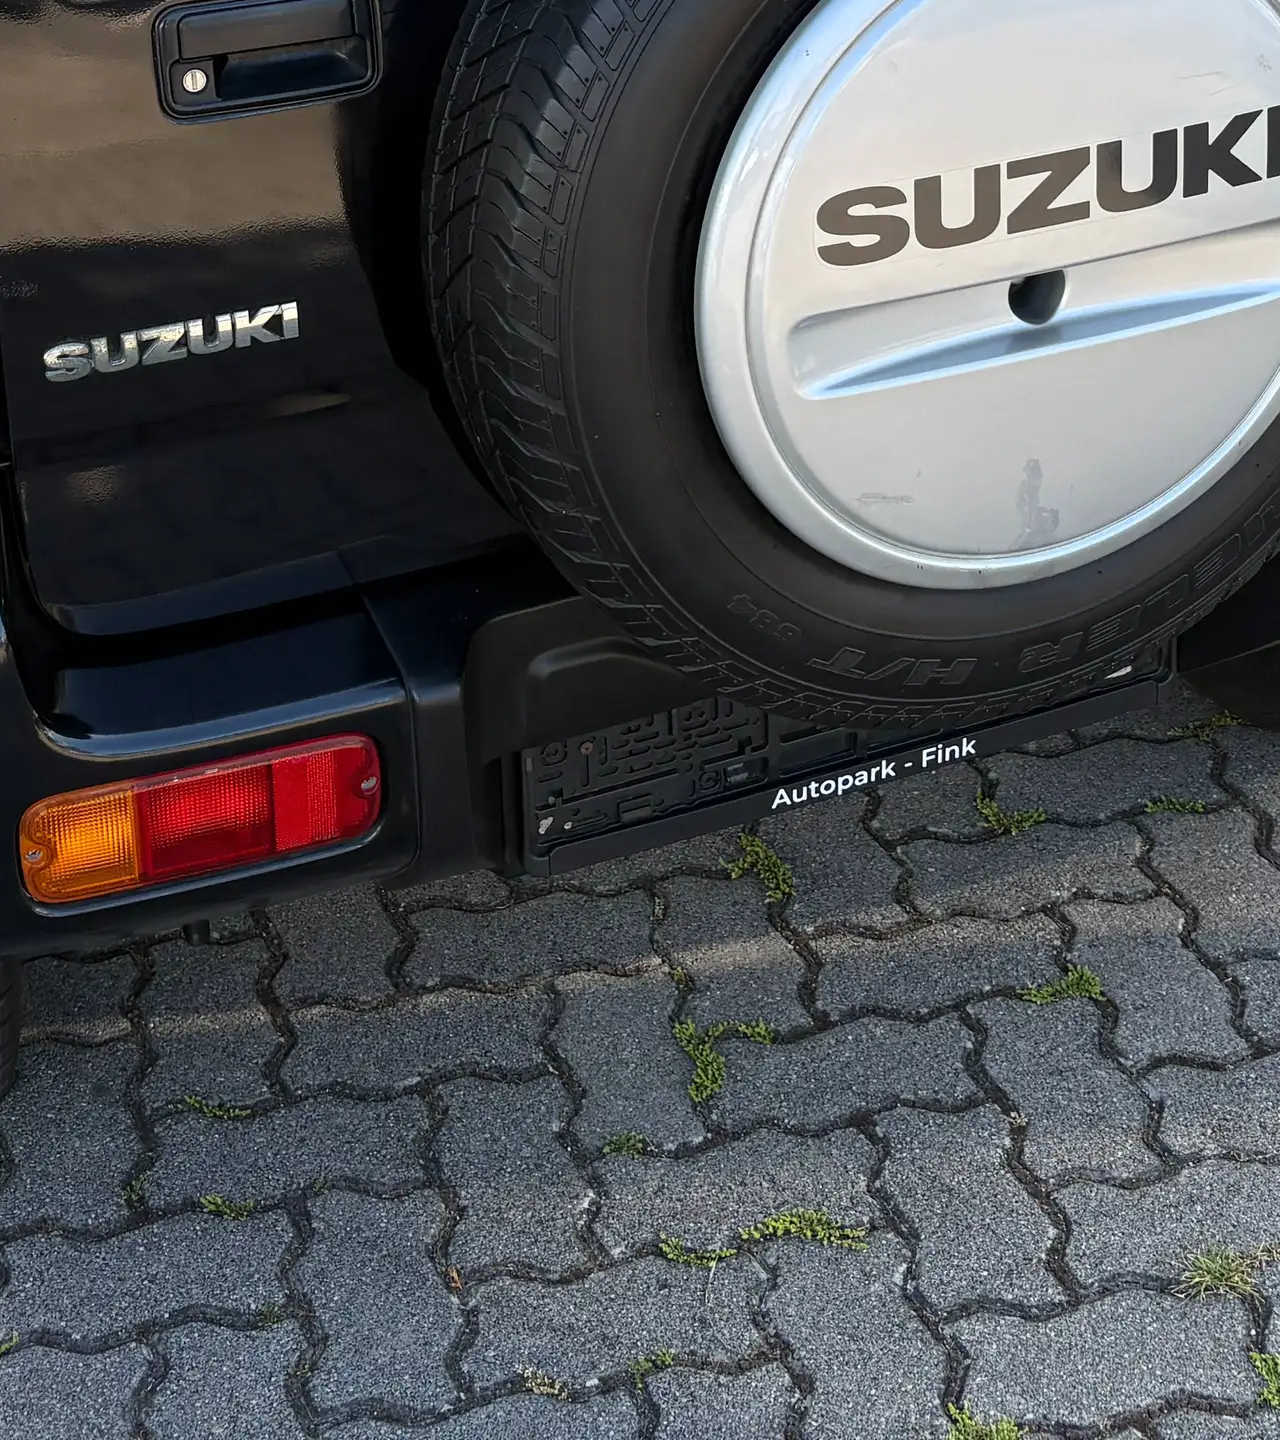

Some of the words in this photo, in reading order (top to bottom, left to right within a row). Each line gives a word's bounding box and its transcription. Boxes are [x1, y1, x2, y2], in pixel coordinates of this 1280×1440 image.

[42, 300, 300, 383] SUZUKI
[771, 758, 896, 809] Autopark
[921, 737, 977, 769] Fink
